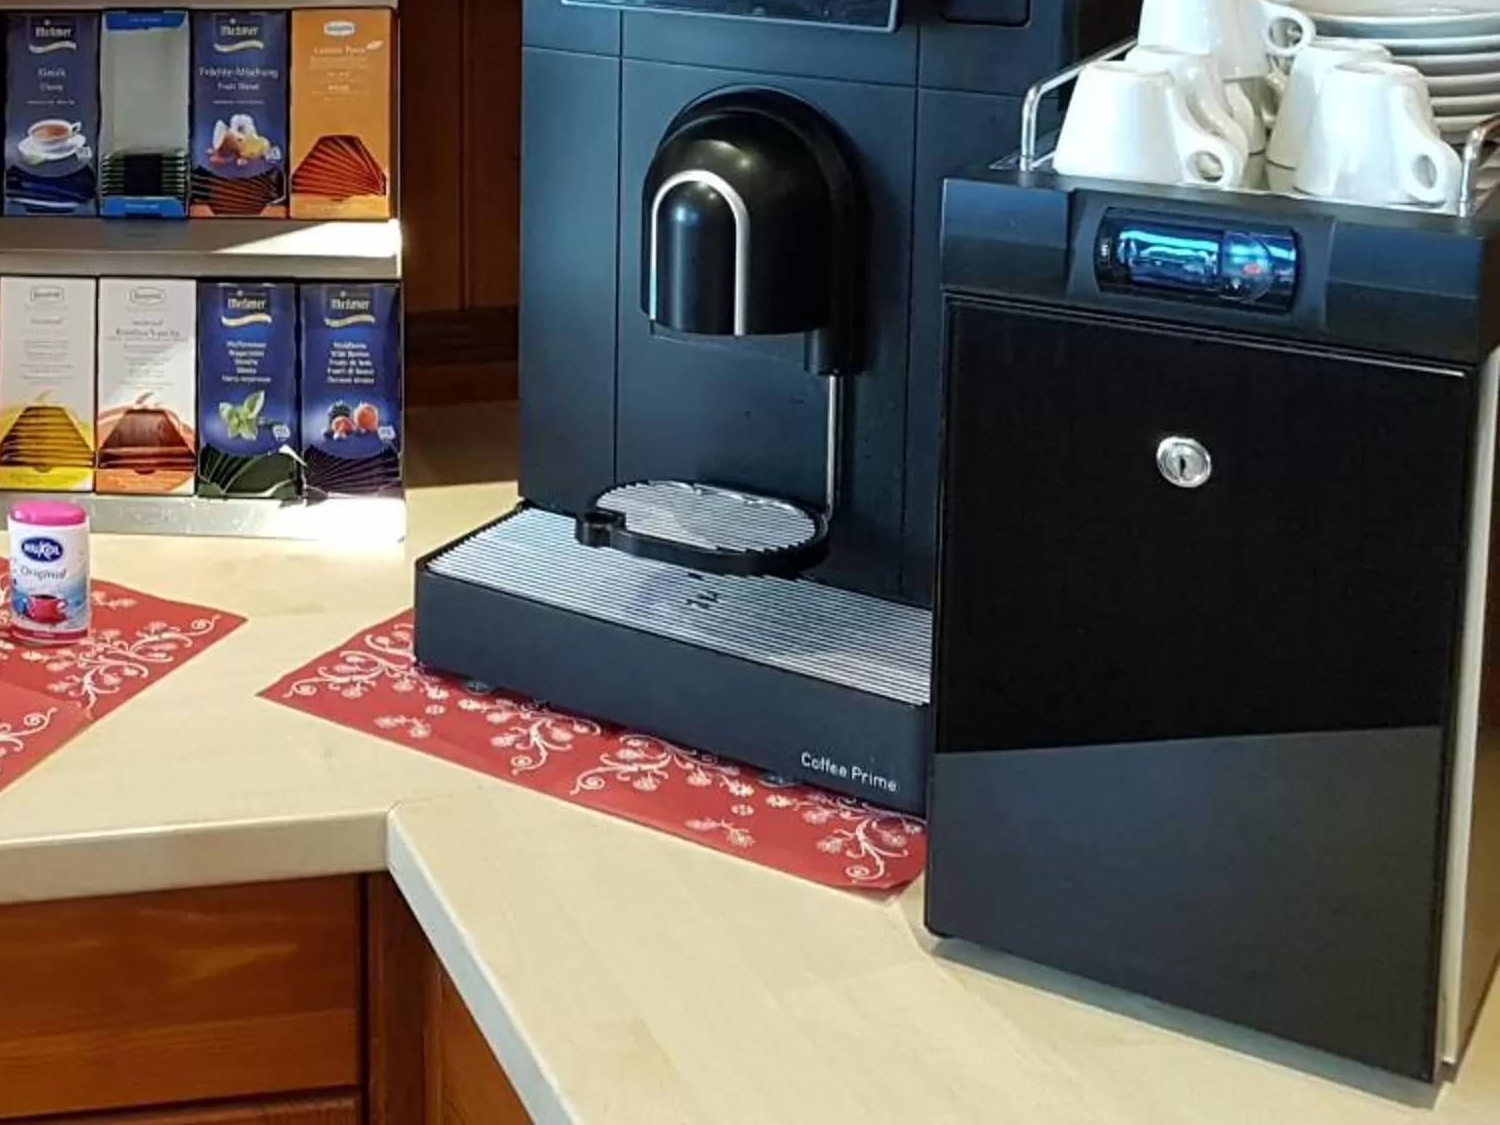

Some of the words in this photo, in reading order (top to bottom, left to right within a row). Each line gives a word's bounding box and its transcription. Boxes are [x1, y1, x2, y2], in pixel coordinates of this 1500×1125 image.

[20, 565, 67, 580] Original
[801, 752, 847, 778] Coffee
[851, 766, 898, 792] Prime
